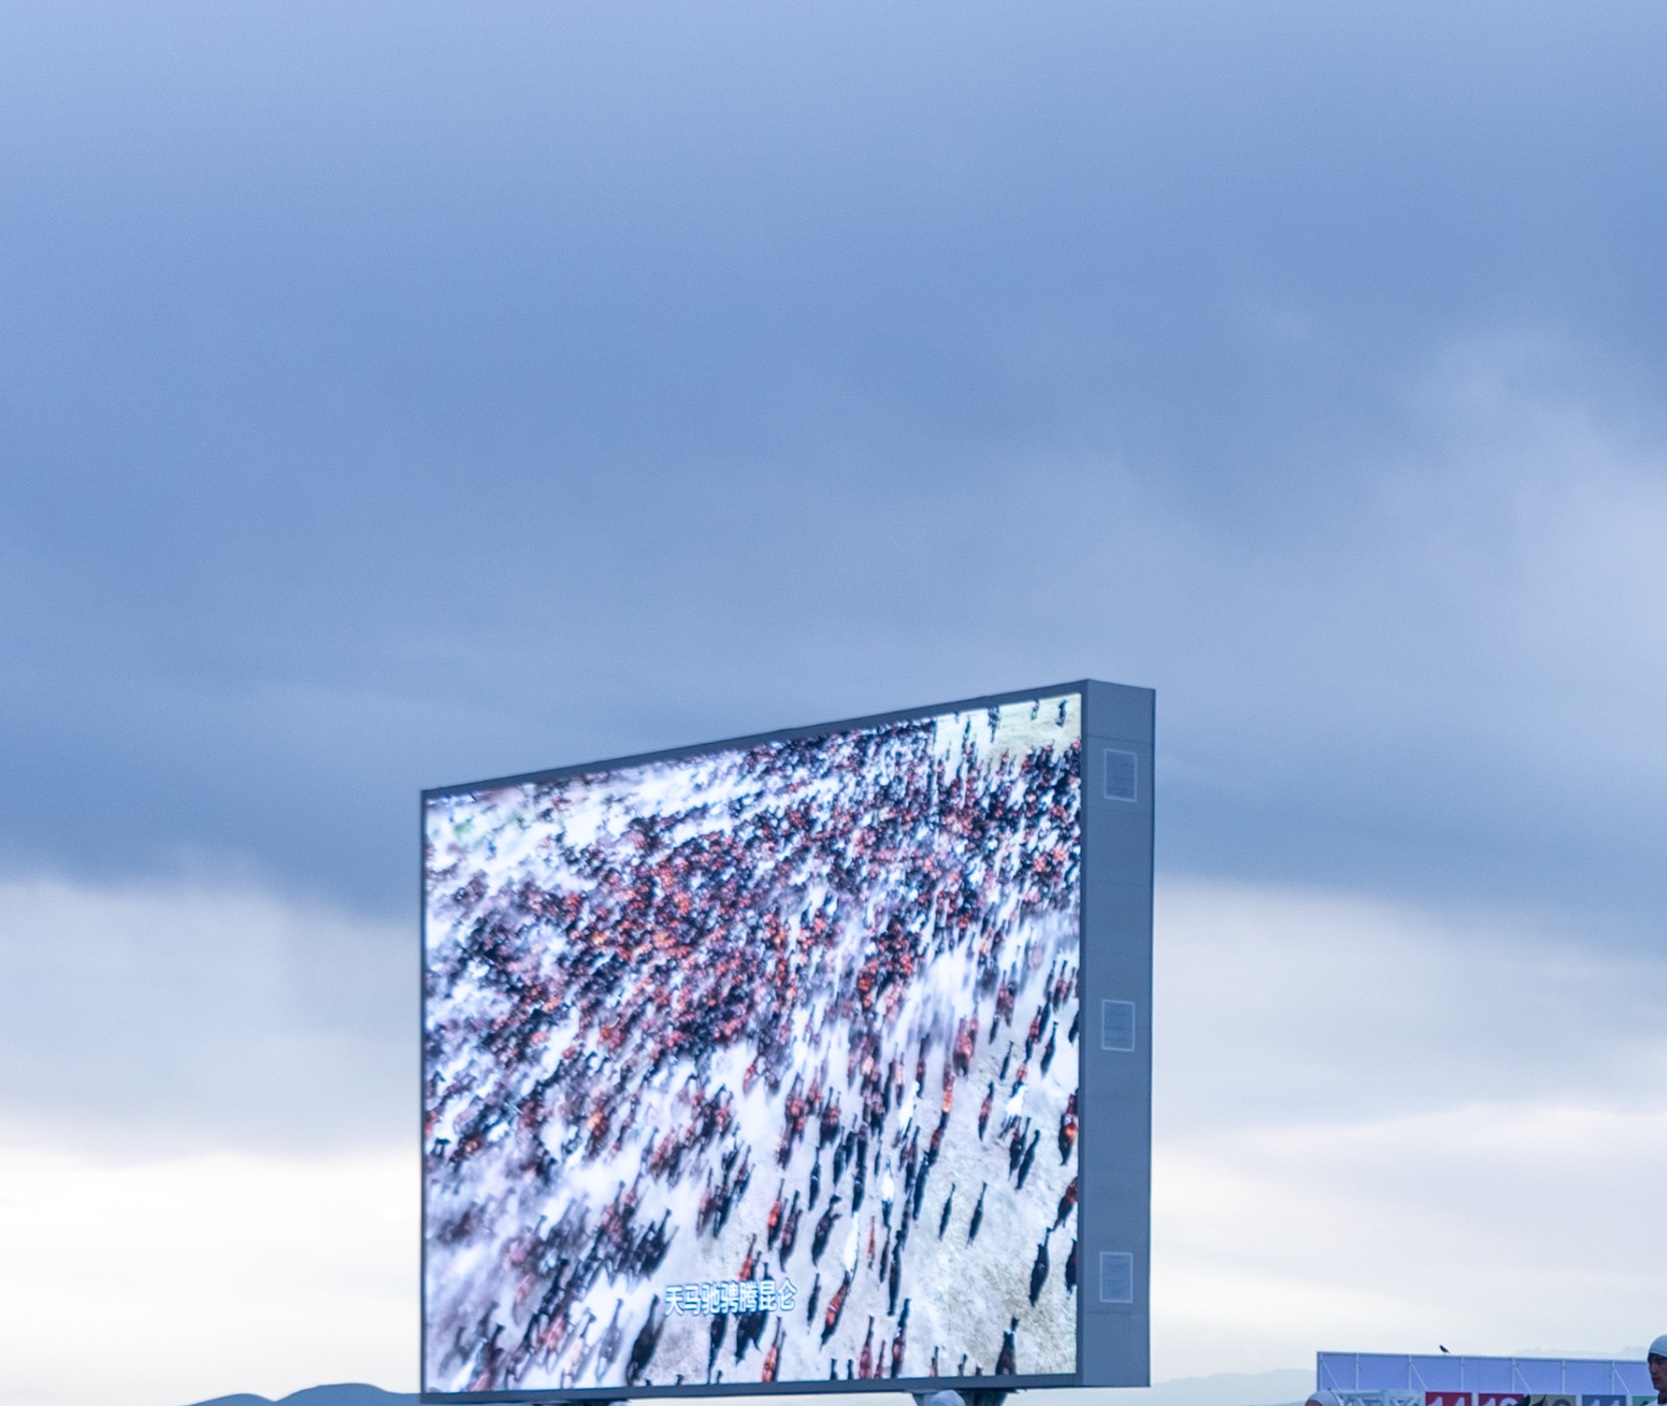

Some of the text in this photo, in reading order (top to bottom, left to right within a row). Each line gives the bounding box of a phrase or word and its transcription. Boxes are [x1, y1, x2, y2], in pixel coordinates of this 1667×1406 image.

[665, 1279, 798, 1316] 天马驰骋腾昆仑
